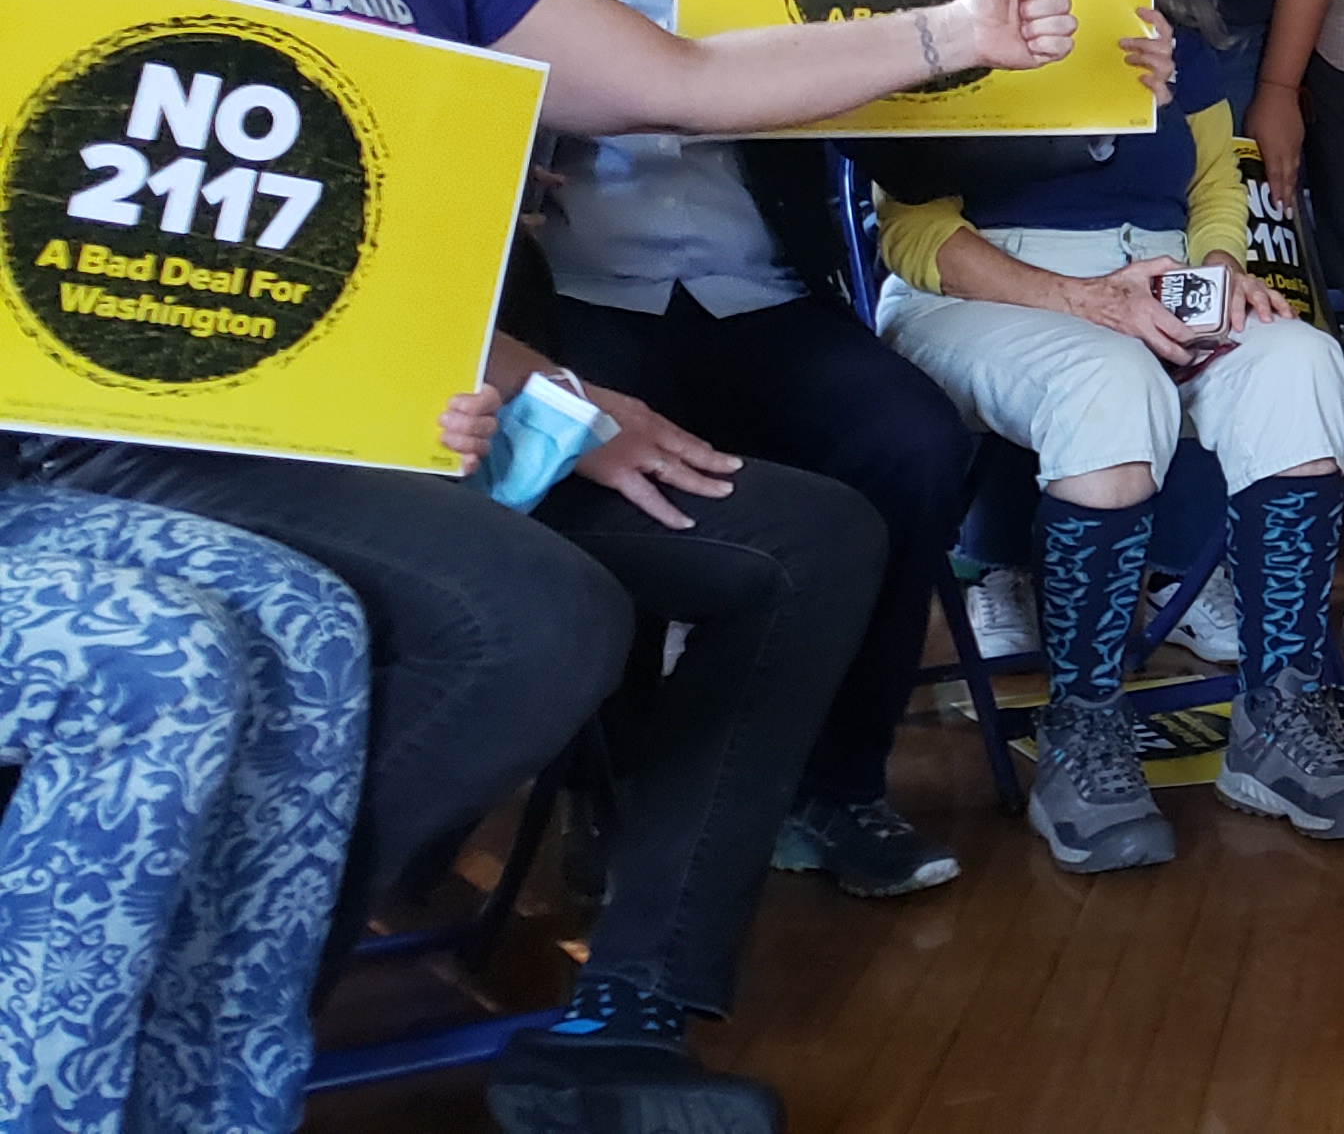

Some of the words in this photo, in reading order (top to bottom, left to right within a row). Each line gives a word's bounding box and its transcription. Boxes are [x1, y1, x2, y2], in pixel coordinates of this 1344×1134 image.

[127, 62, 301, 162] NO
[67, 143, 323, 250] 2117
[35, 239, 70, 270] A
[78, 244, 158, 282] Bad
[160, 257, 248, 296] Deal
[249, 270, 312, 304] For
[60, 282, 276, 339] Washington
